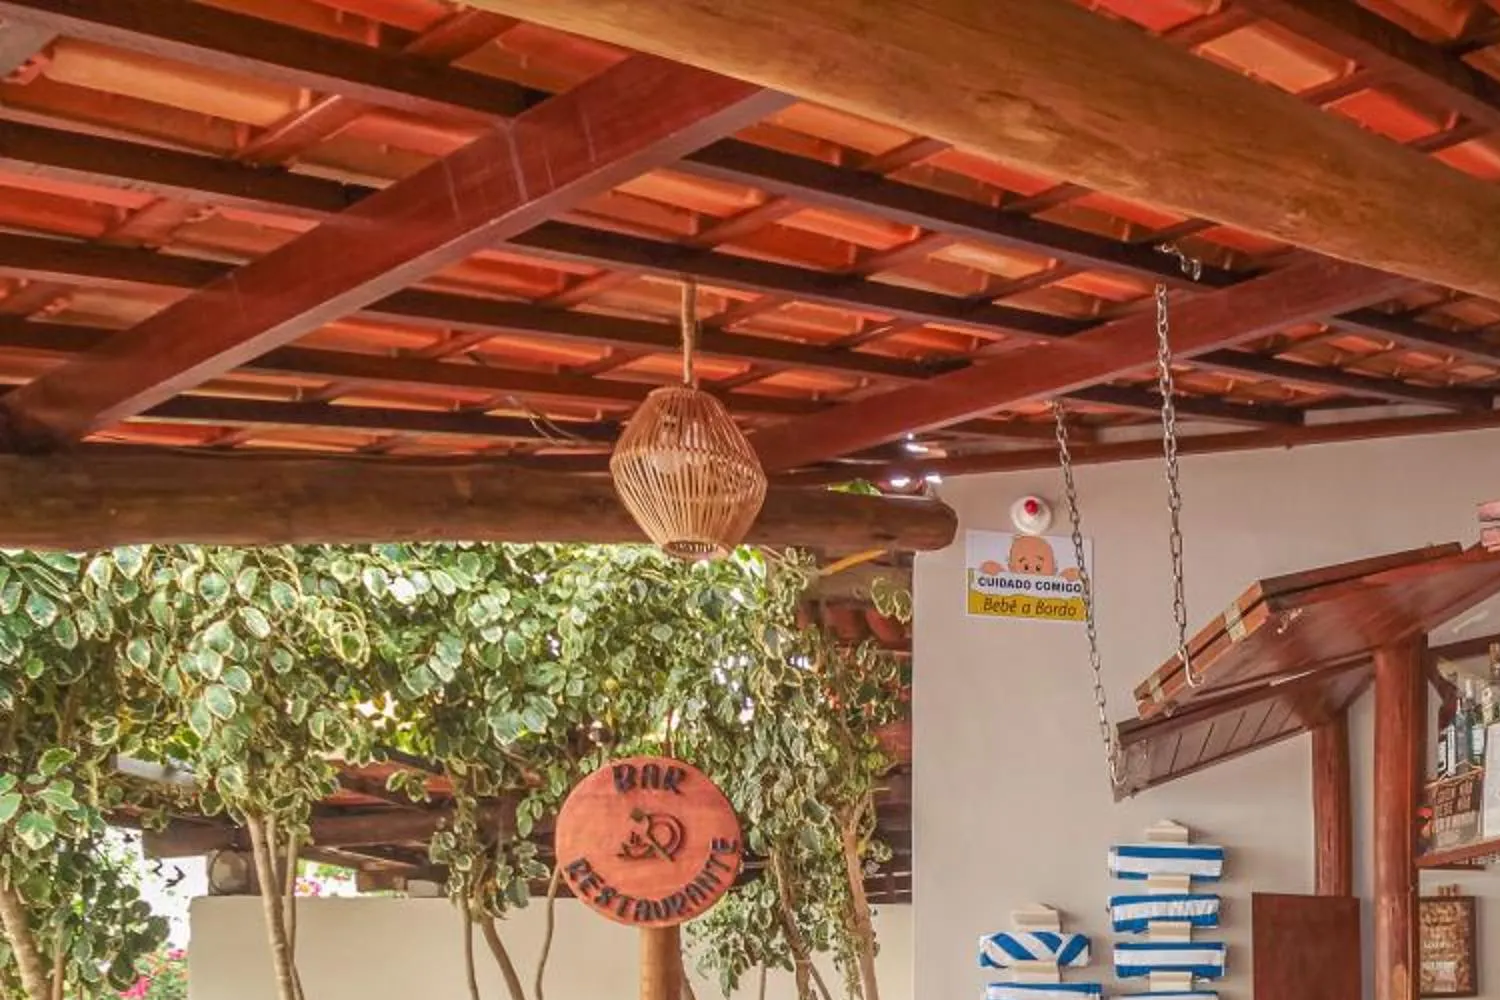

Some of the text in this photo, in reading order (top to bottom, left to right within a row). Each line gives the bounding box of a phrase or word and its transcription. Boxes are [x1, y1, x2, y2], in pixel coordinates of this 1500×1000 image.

[978, 577, 1082, 593] CUIDADO COMIGO
[1021, 603, 1031, 614] a
[1035, 600, 1077, 617] Bordo
[612, 763, 687, 795] BAR
[564, 837, 738, 922] RESTAURANTE
